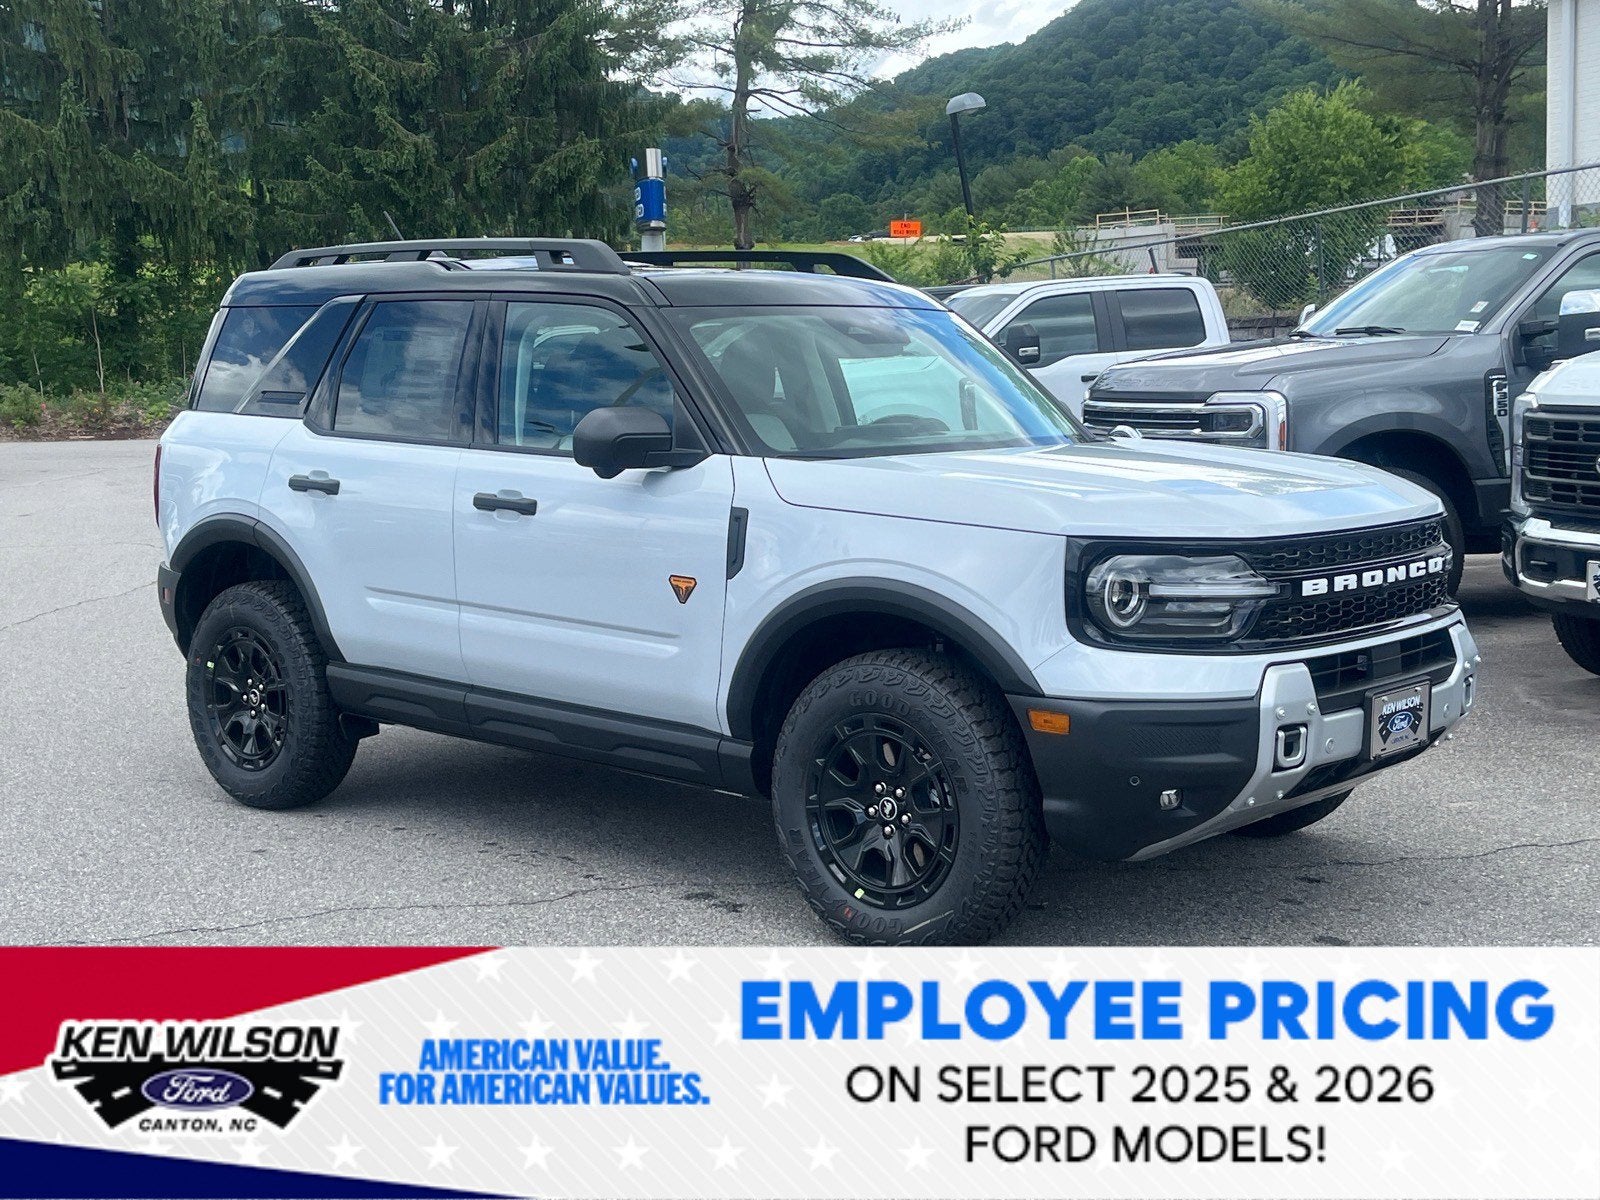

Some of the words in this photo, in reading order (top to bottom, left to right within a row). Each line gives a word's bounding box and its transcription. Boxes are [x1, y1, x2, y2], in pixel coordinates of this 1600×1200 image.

[1301, 556, 1443, 597] BRONCO
[1381, 701, 1396, 716] KEN
[1396, 694, 1421, 712] WILSON
[1392, 714, 1409, 731] Ford
